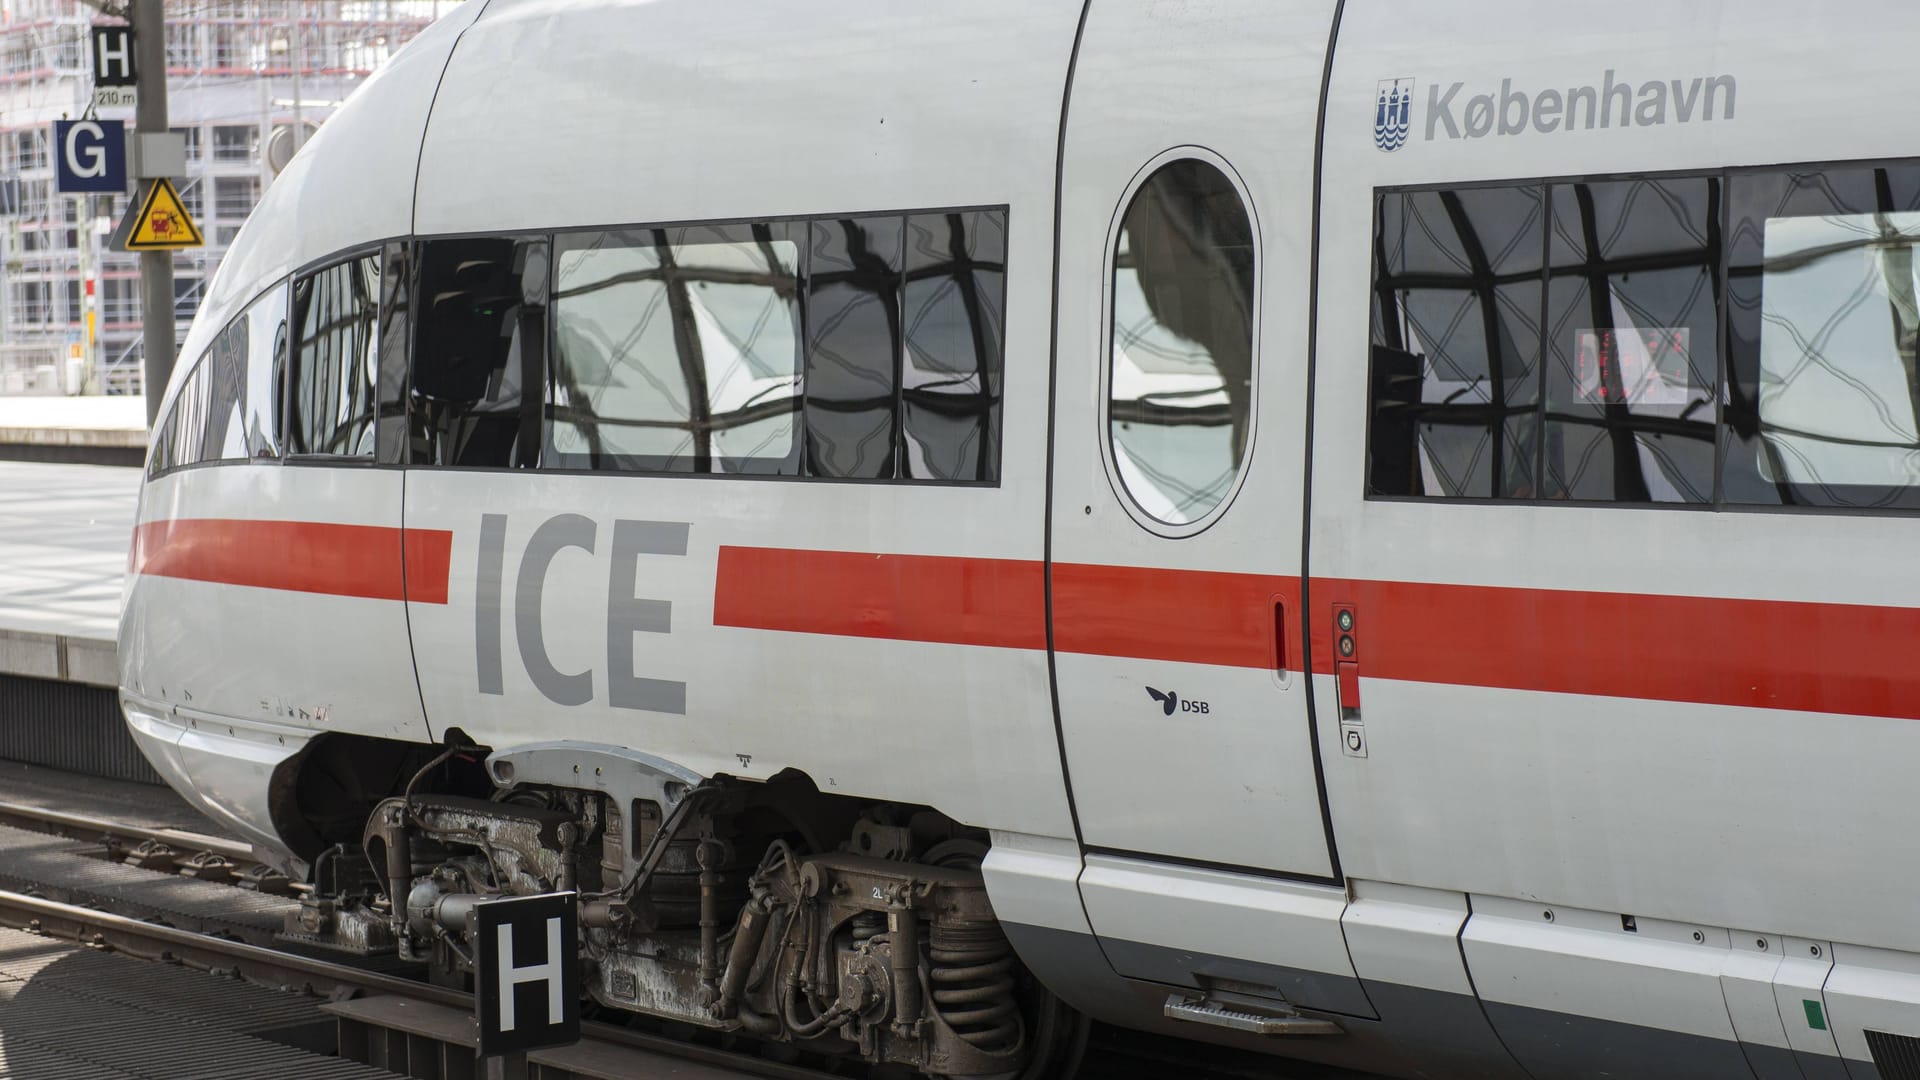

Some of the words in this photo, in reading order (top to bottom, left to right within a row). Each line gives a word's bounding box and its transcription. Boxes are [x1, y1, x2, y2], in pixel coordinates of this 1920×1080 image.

[98, 32, 130, 78] H
[98, 91, 119, 105] 210
[122, 94, 135, 104] m
[1424, 69, 1737, 141] København
[65, 121, 107, 179] G
[475, 513, 690, 715] ICE
[1181, 699, 1210, 714] DSB
[872, 886, 884, 899] 2L
[497, 916, 564, 1032] H
